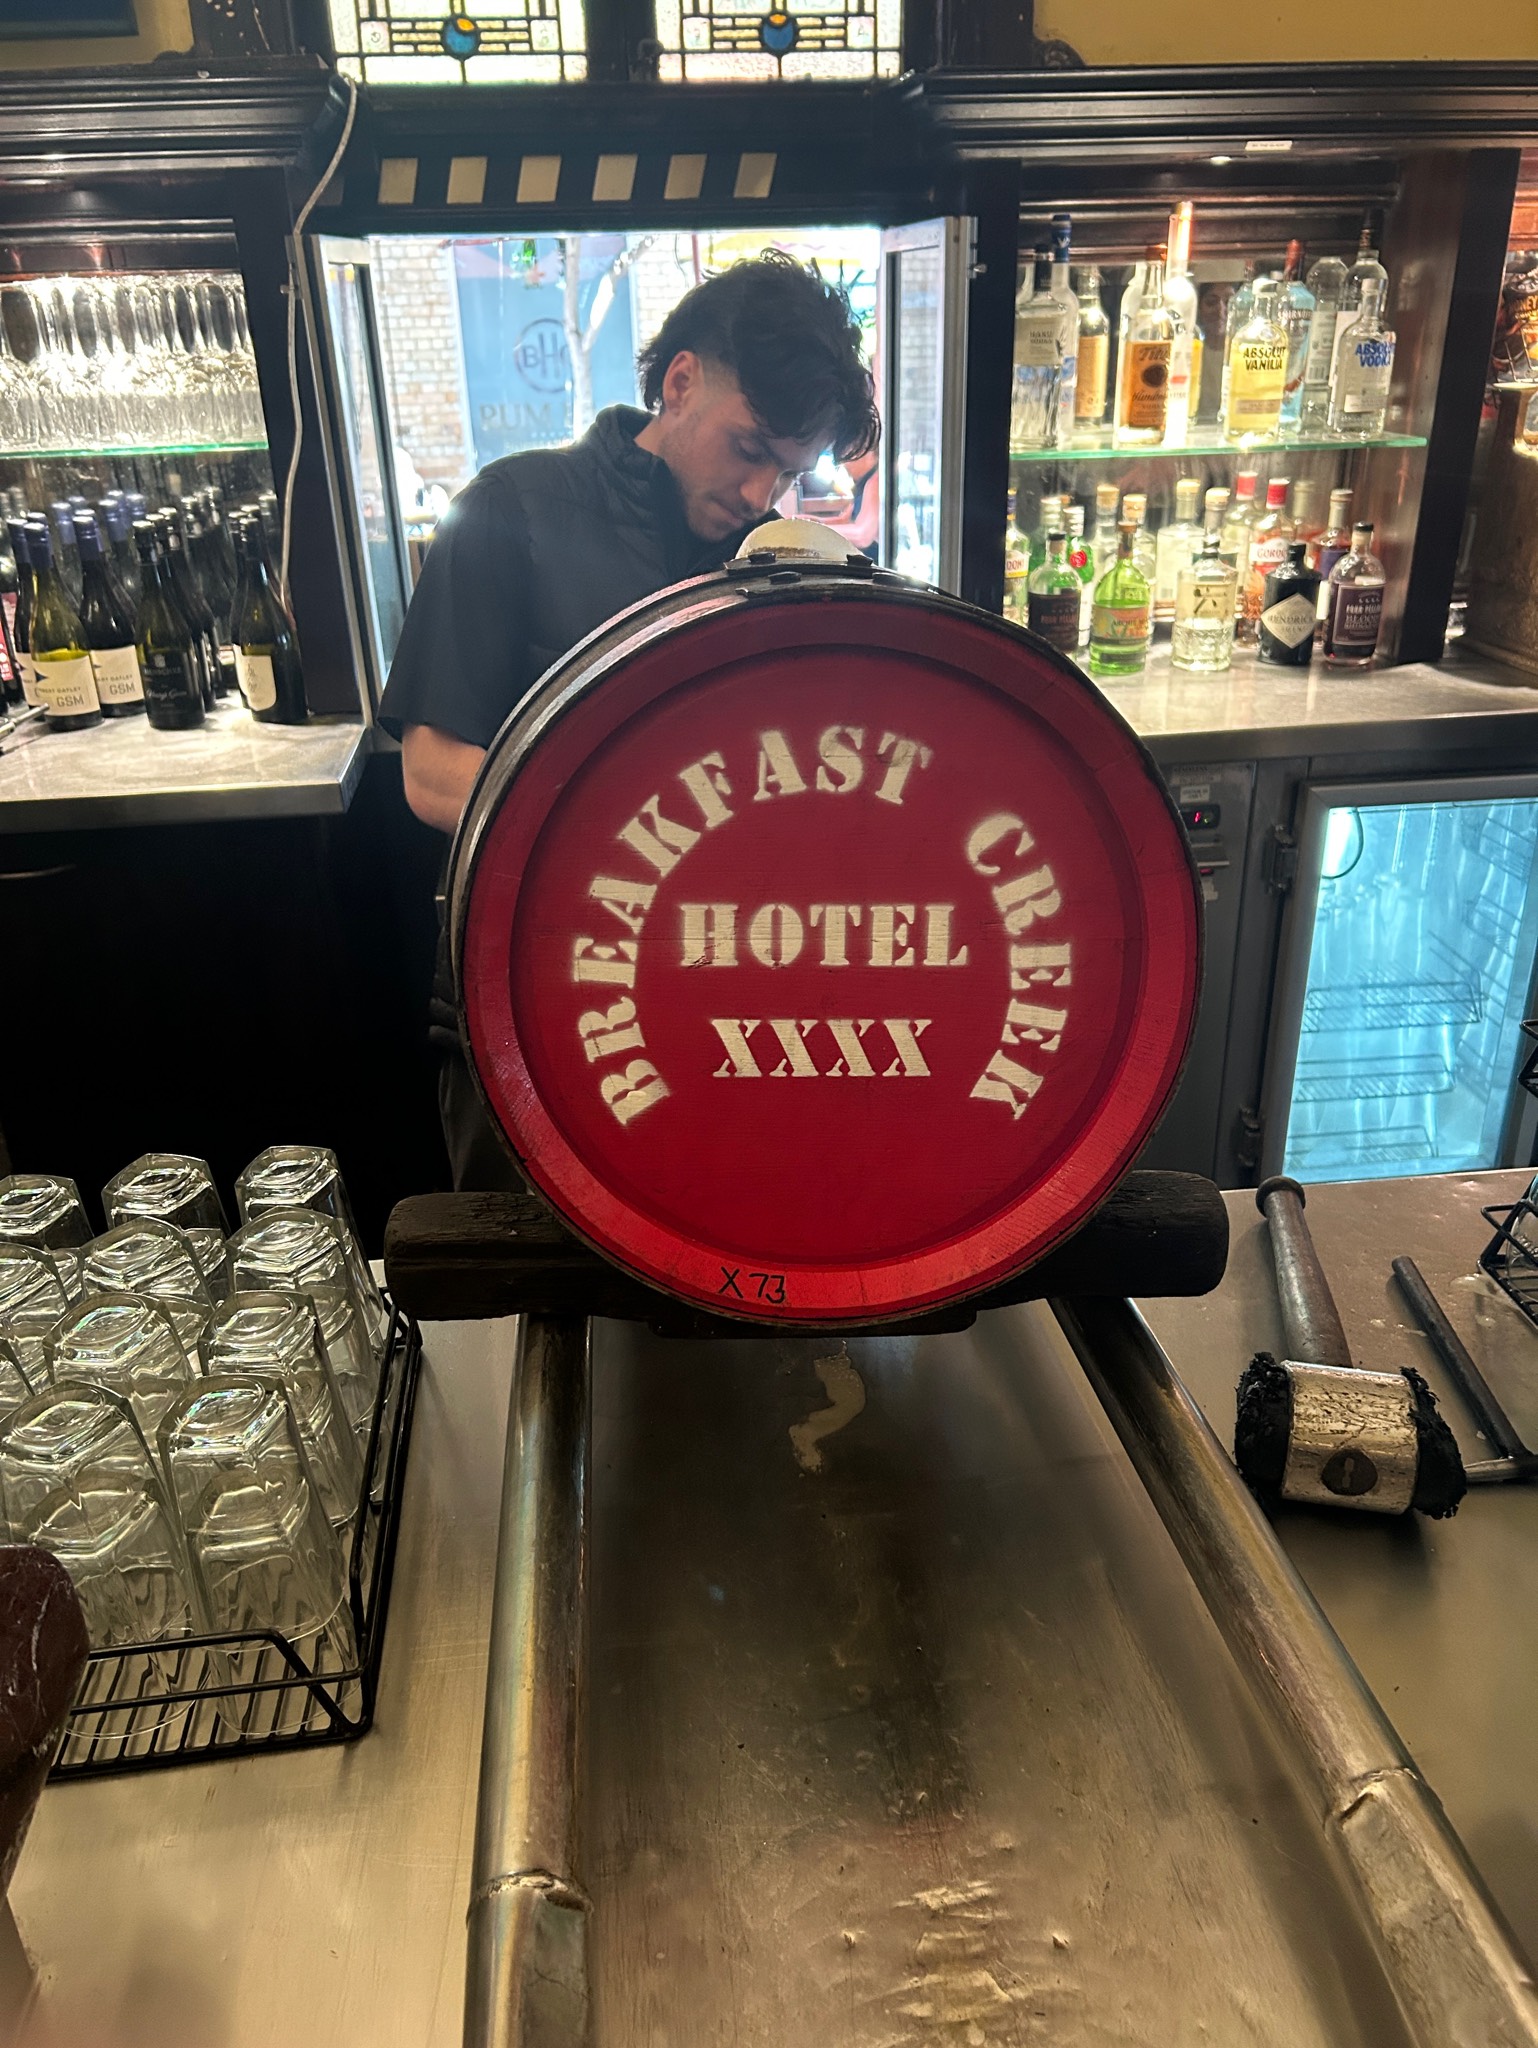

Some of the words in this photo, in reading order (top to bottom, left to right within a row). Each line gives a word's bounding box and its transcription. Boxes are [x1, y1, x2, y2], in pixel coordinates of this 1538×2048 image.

[1243, 346, 1287, 359] ABSOLUT
[56, 695, 85, 708] GSM
[109, 682, 136, 696] GSM
[572, 725, 933, 1126] BREAKFAST
[963, 811, 1074, 1121] CREEK
[679, 903, 969, 968] HOTEL
[711, 1018, 933, 1078] XXXX
[718, 1265, 744, 1299] X
[748, 1272, 786, 1304] 73
